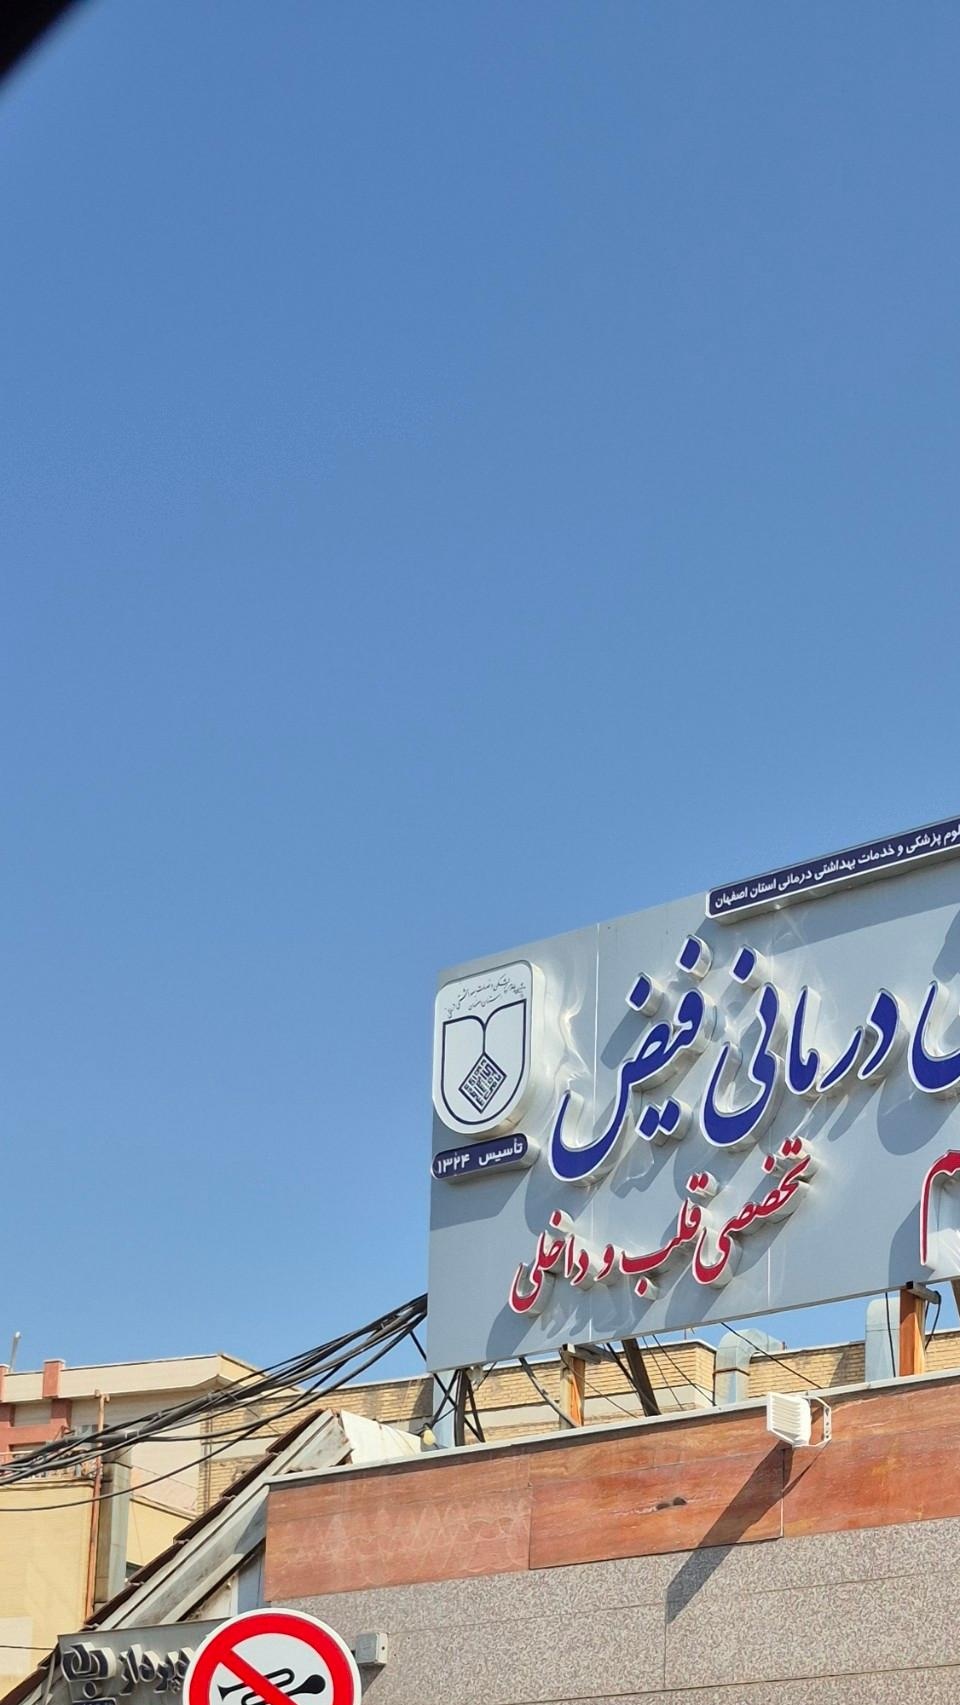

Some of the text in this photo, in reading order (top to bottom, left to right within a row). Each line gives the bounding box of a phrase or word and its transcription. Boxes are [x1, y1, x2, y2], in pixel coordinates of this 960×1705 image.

[857, 844, 895, 864] خدمات
[897, 844, 904, 857] و
[905, 833, 941, 854] پزشکی
[778, 870, 813, 891] درمانی
[814, 858, 856, 881] بهداشتی
[714, 886, 748, 908] اصفهان
[749, 878, 777, 898] استان
[702, 946, 900, 1145] درمانی
[550, 937, 705, 1180] فیض
[478, 1138, 523, 1166] تأسیس
[509, 1138, 810, 1314] تخصصی قلب و داخلی
